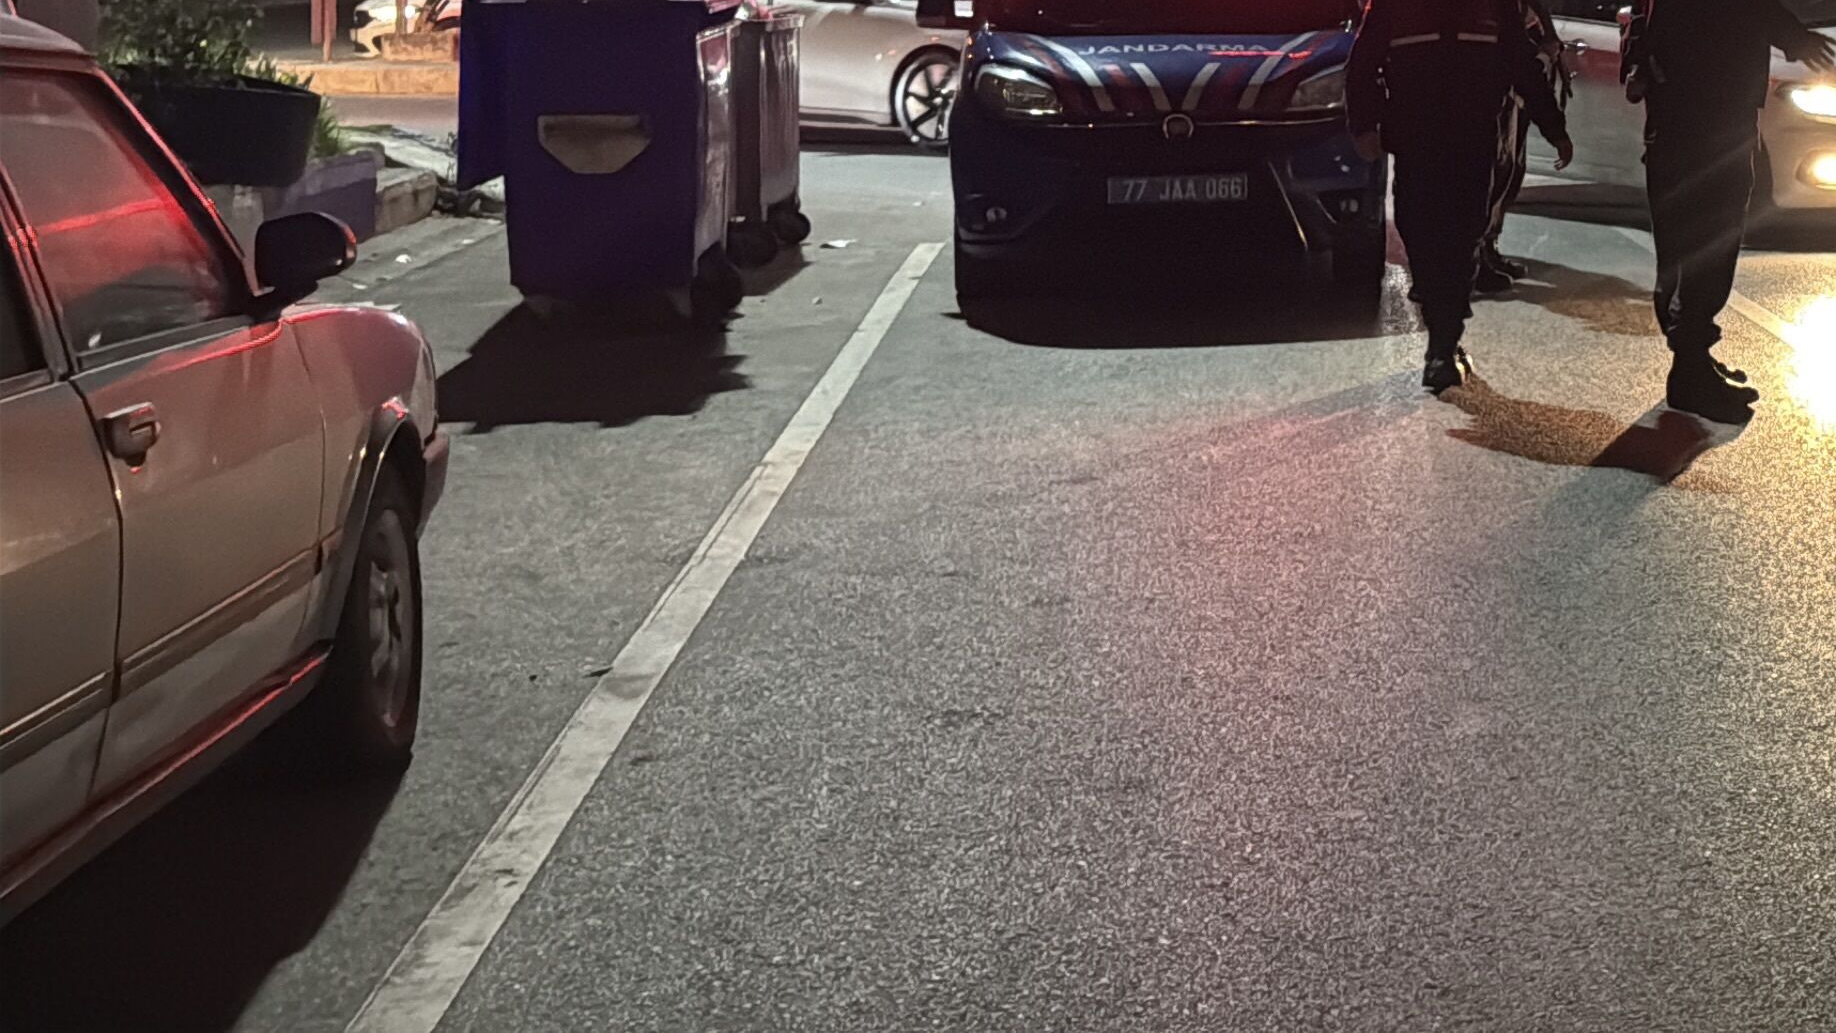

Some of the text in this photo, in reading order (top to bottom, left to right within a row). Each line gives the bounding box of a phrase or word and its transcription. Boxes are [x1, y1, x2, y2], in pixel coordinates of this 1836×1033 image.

[1078, 43, 1271, 56] JANDARMA
[1122, 177, 1243, 202] 77 JAA 066
